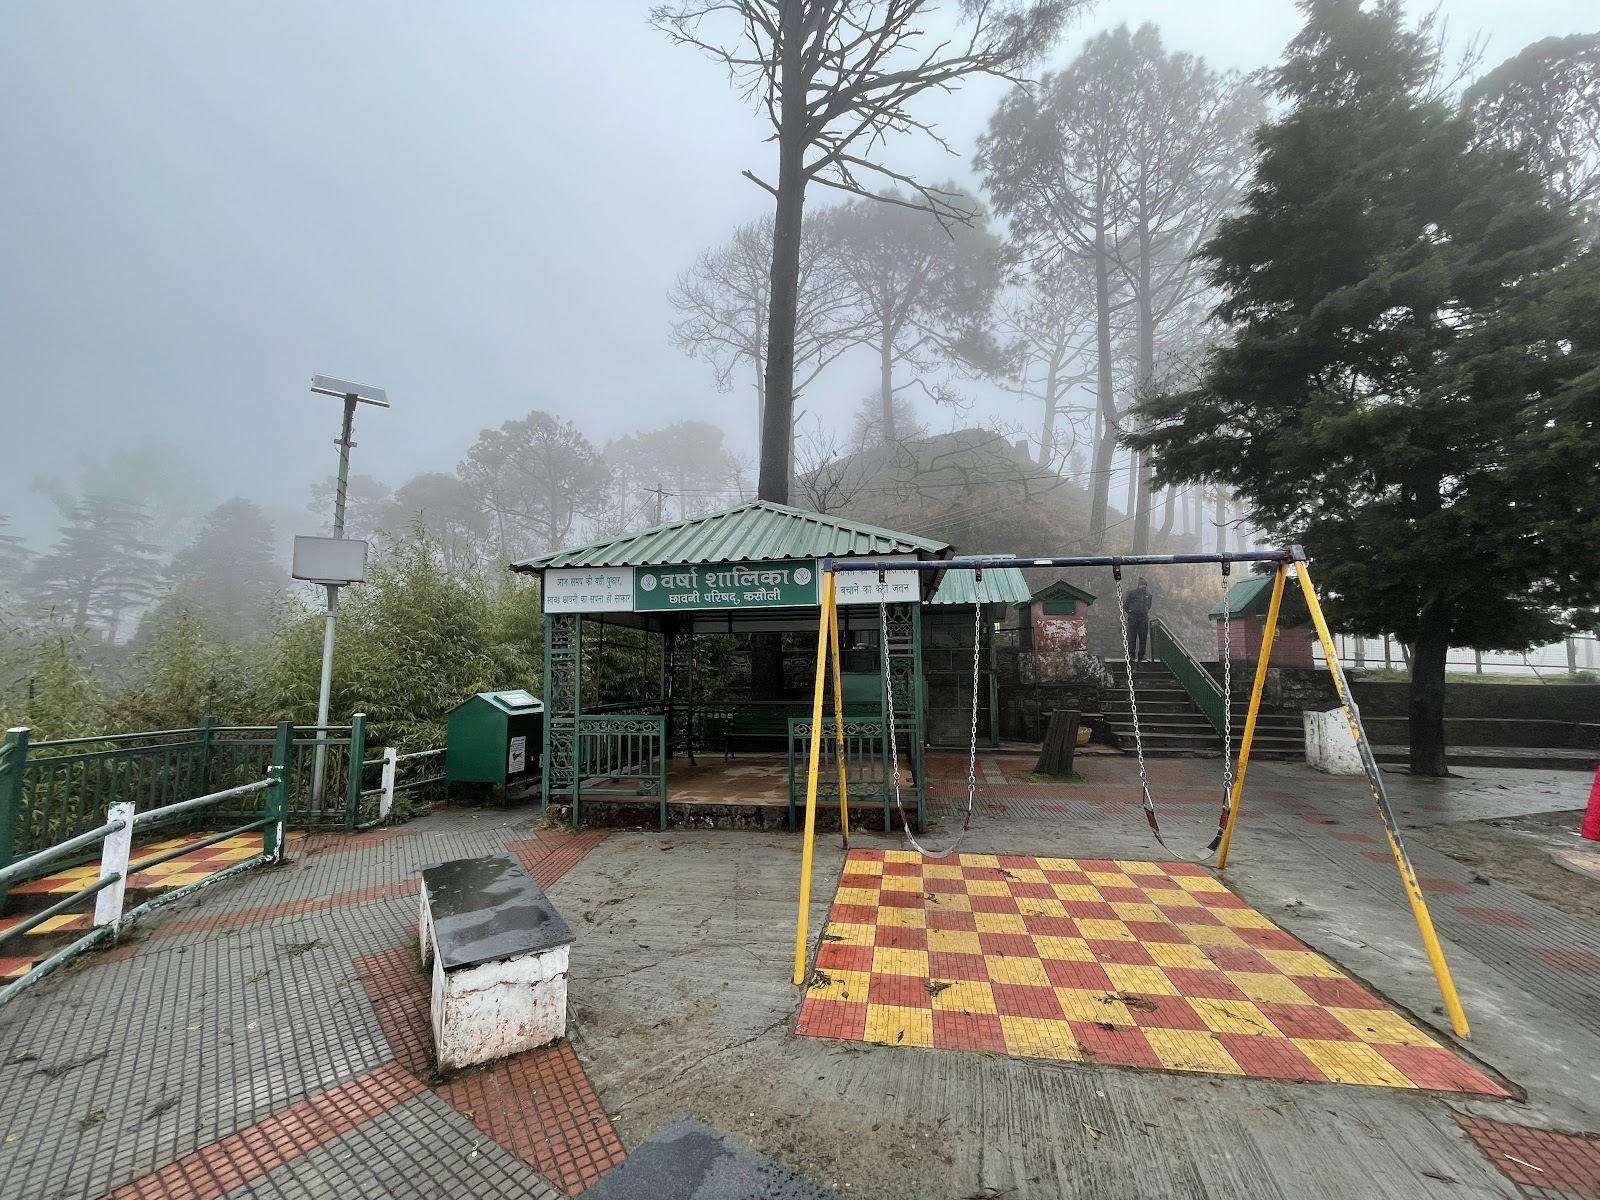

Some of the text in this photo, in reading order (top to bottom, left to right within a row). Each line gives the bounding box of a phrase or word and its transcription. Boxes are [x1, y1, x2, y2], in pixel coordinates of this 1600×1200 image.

[557, 578, 568, 587] आज
[570, 577, 583, 586] समय
[661, 566, 789, 588] वर्षा शालिका
[840, 583, 859, 595] बचाने
[863, 585, 872, 594] का
[892, 583, 909, 593] जतन
[547, 596, 560, 604] स्वच्छ
[562, 593, 578, 604] छावनी
[581, 595, 587, 603] का
[590, 595, 603, 603] सपना
[606, 592, 612, 603] हो
[669, 590, 700, 604] छावनी
[743, 587, 781, 602] कसौली
